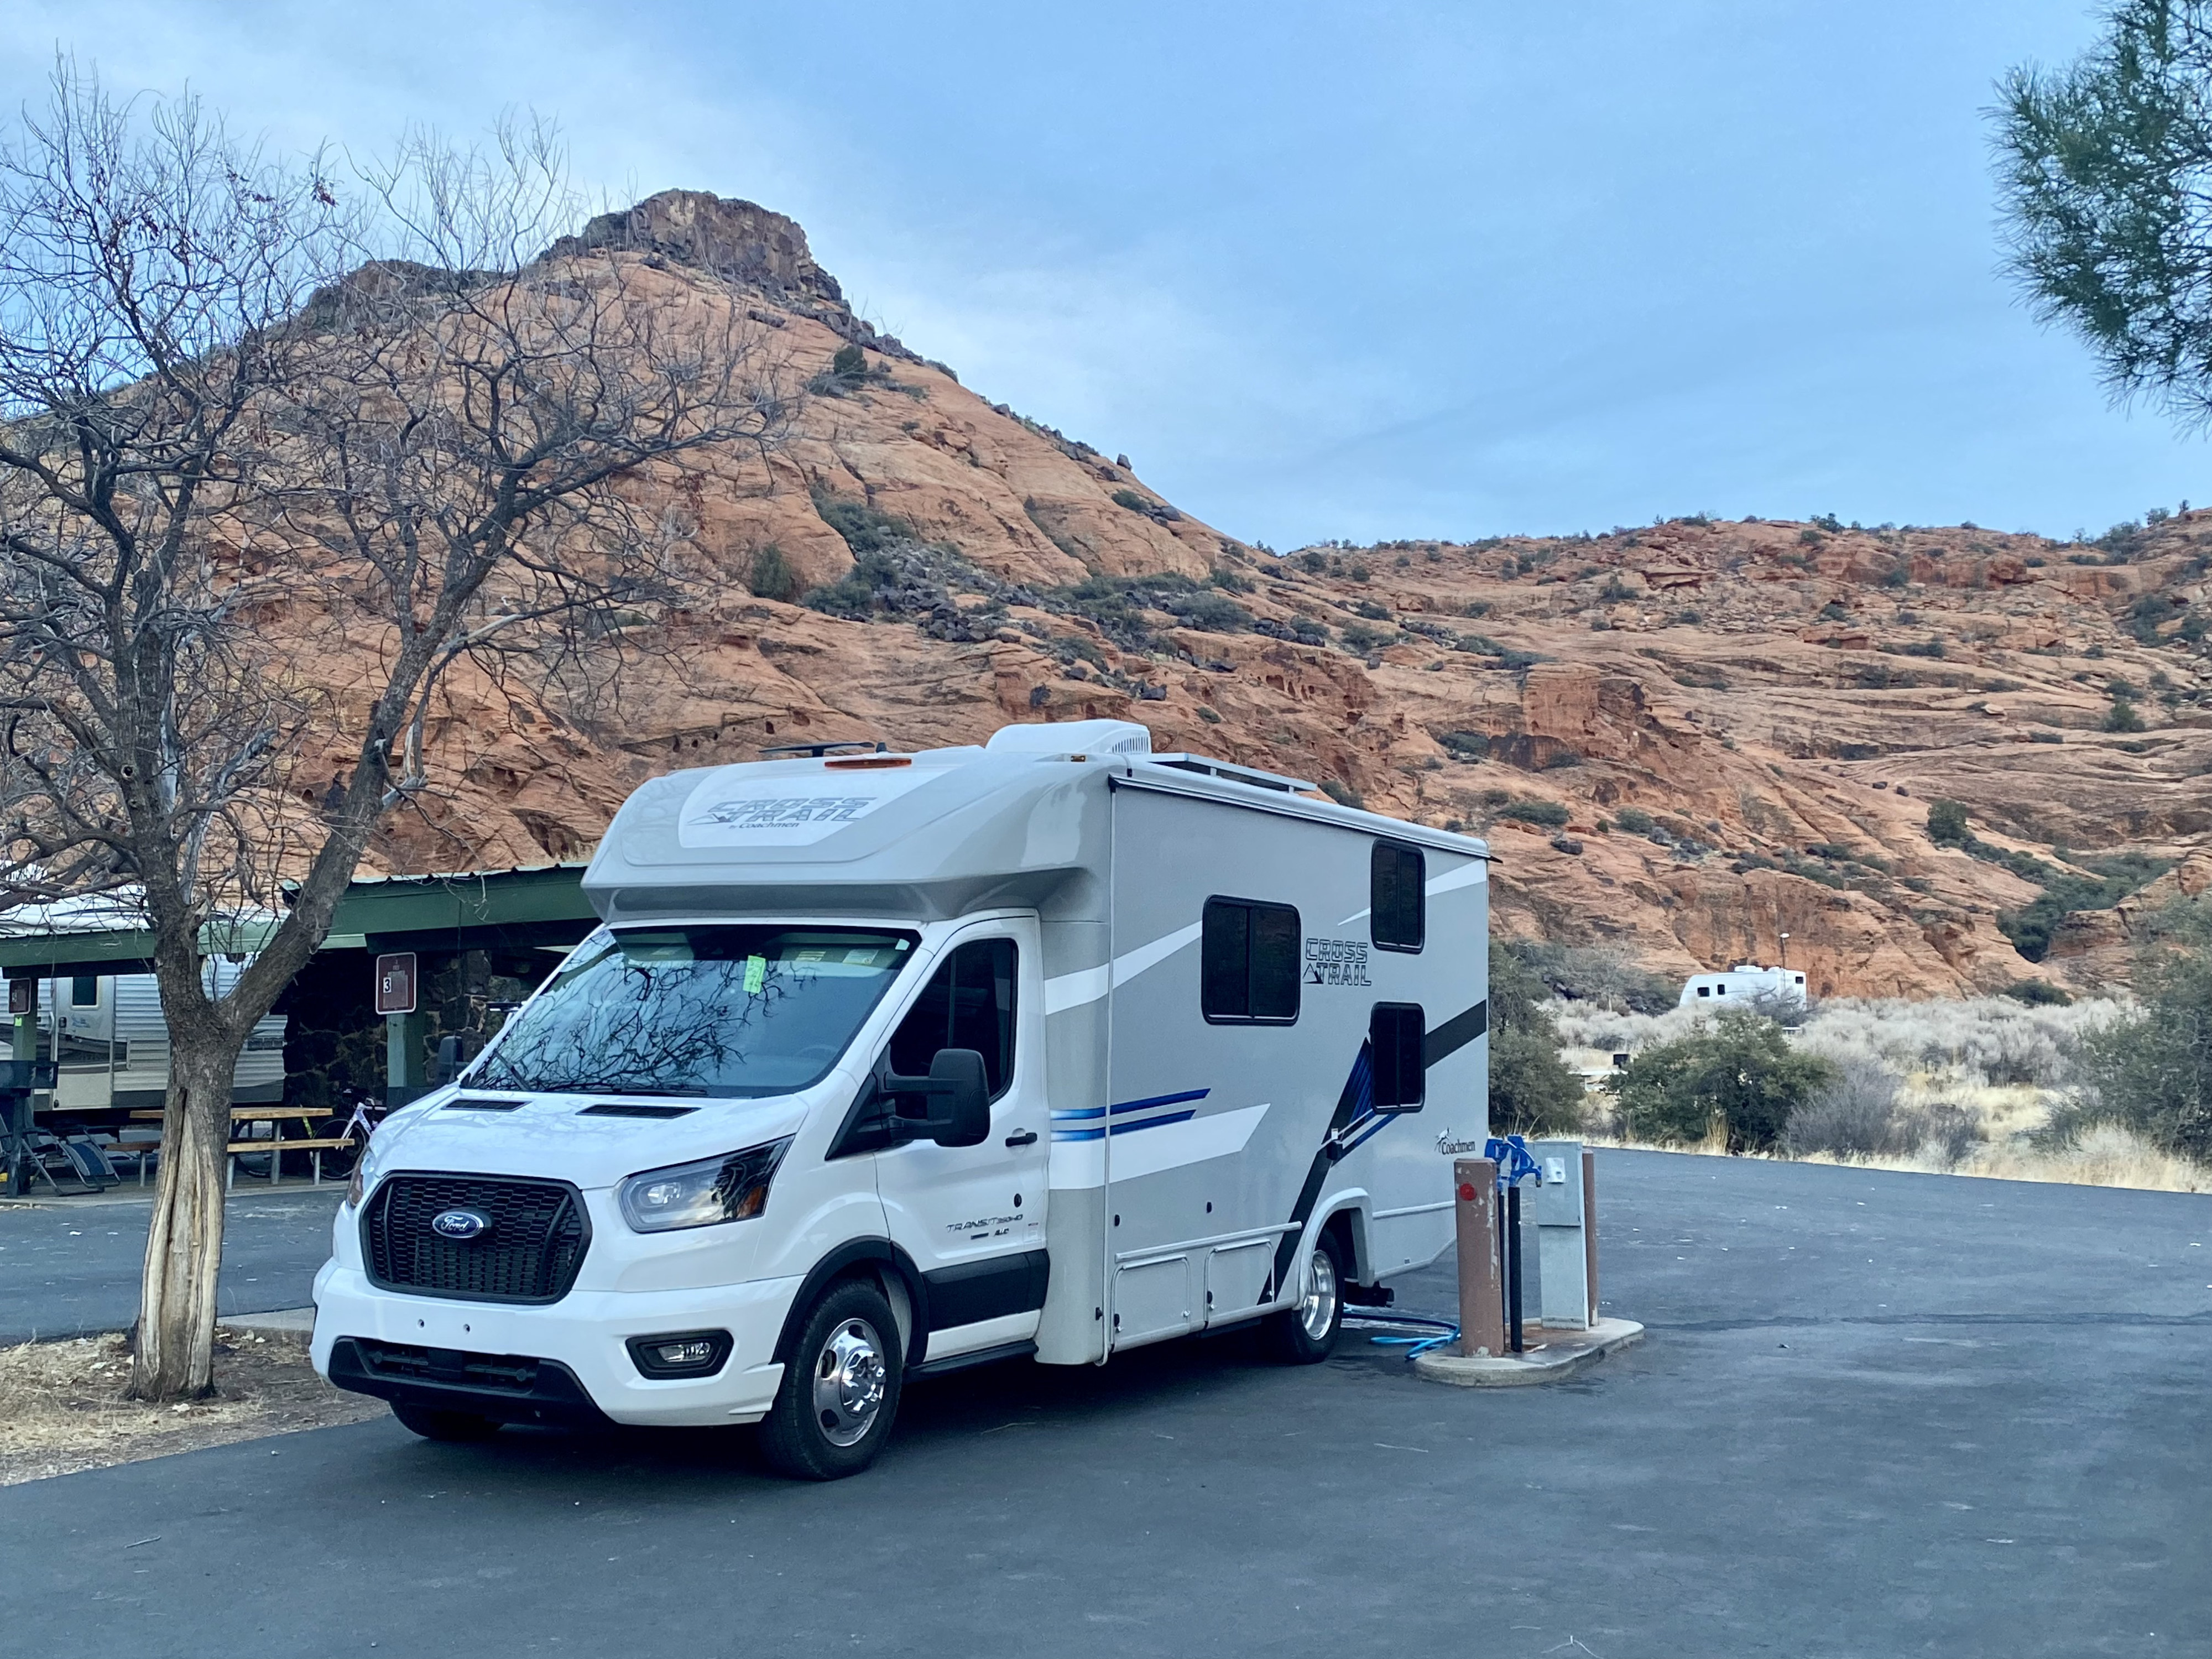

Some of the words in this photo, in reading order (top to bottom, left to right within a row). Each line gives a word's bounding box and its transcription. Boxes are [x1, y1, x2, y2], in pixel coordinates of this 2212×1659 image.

[707, 797, 878, 813] CROSS
[726, 808, 862, 822] TRAIL
[1305, 937, 1368, 964] CROSS
[1316, 962, 1372, 987] TRAIL
[384, 978, 390, 992] 3
[1441, 1138, 1475, 1155] Coachmen
[441, 1215, 469, 1232] Ford
[946, 1217, 998, 1233] TRANSIT
